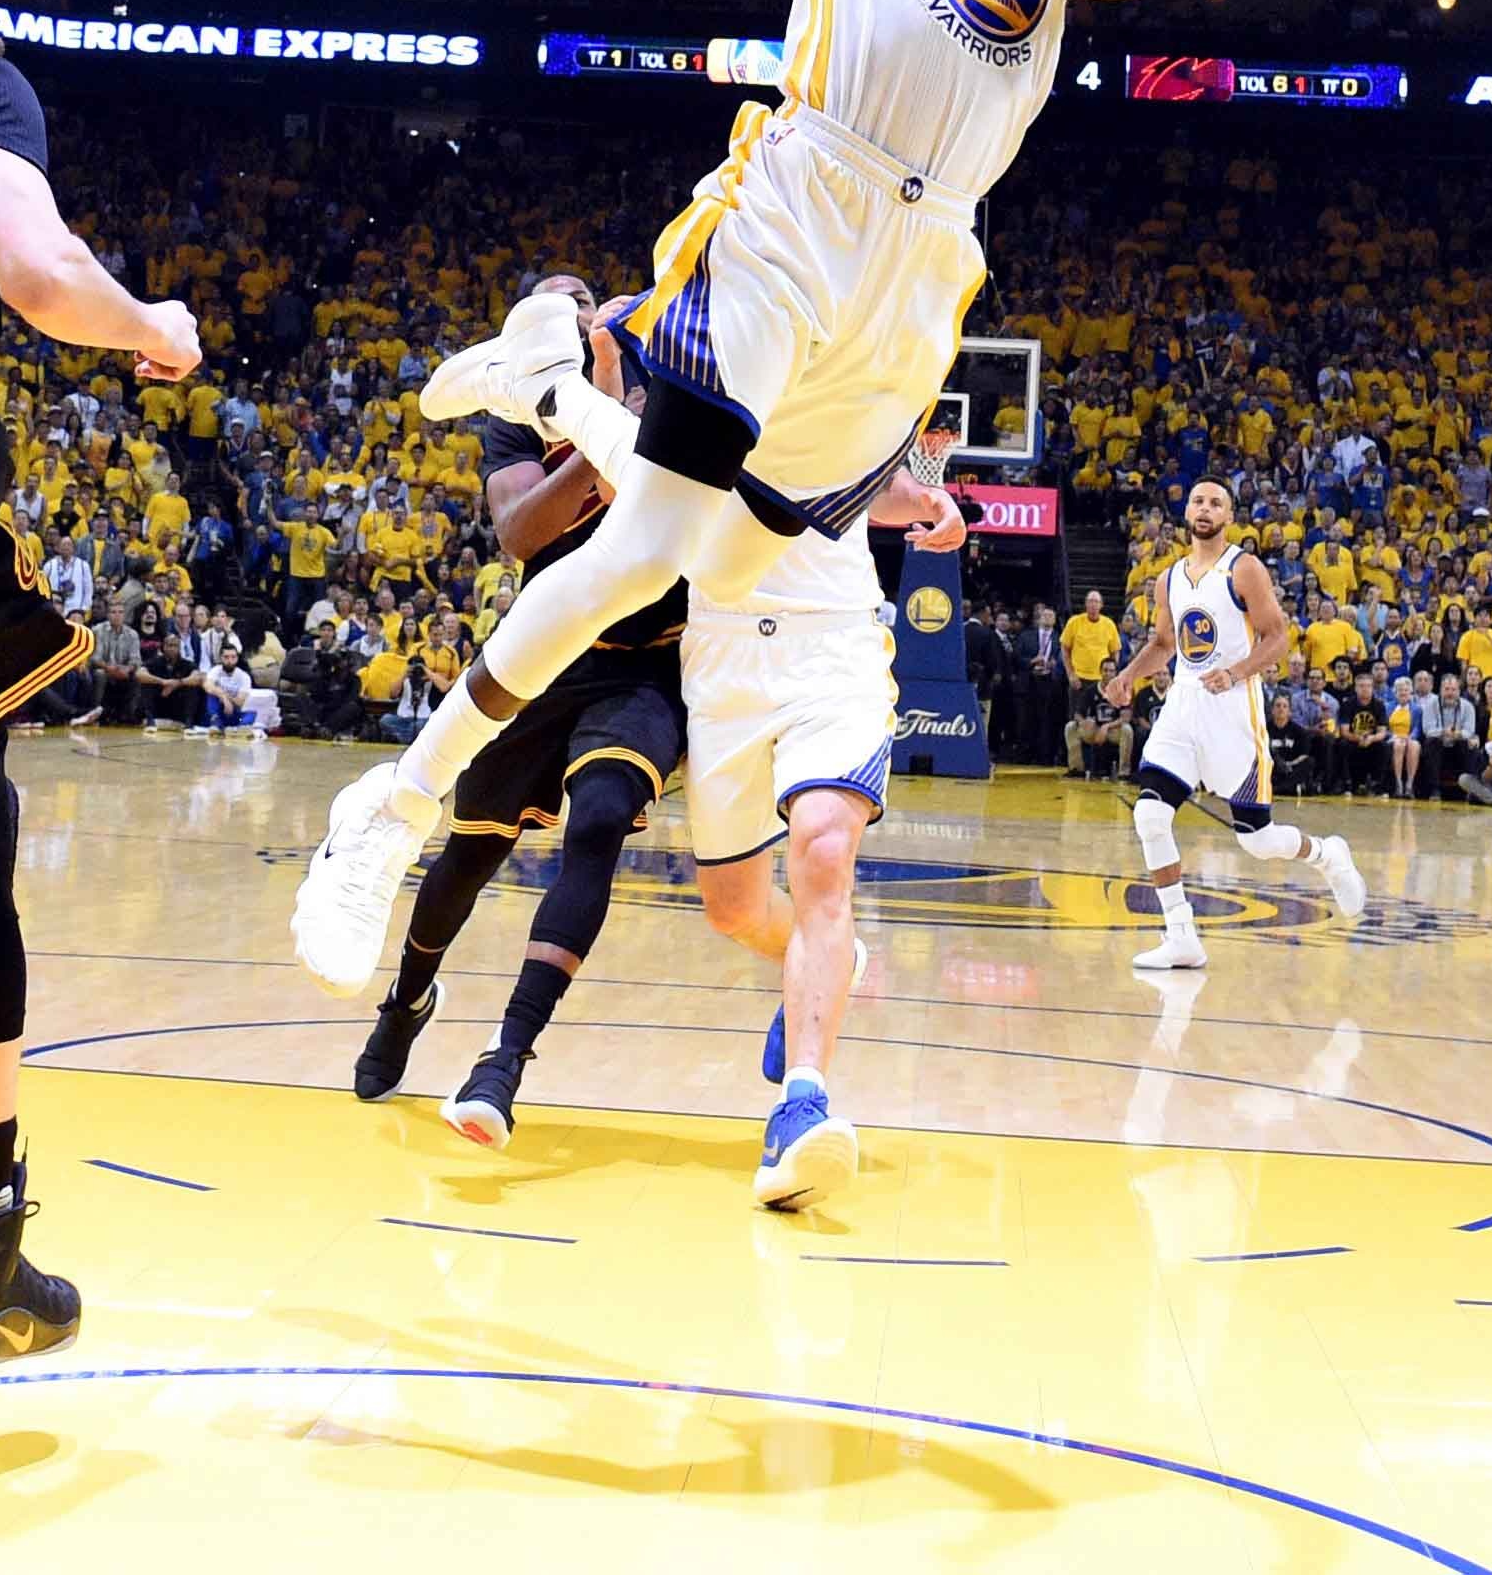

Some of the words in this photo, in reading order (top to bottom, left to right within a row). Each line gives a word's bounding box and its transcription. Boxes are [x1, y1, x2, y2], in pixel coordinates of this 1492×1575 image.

[253, 28, 480, 66] EXPRESS
[611, 49, 623, 67] 1
[639, 51, 668, 69] TOL
[671, 52, 687, 71] 6
[693, 54, 704, 71] 1
[1076, 60, 1101, 91] 4
[1238, 74, 1269, 93] TOL
[1272, 74, 1288, 93] 6
[1294, 76, 1306, 94] 1
[1341, 77, 1358, 96] 0
[1194, 618, 1211, 635] 30
[893, 708, 977, 741] Finals
